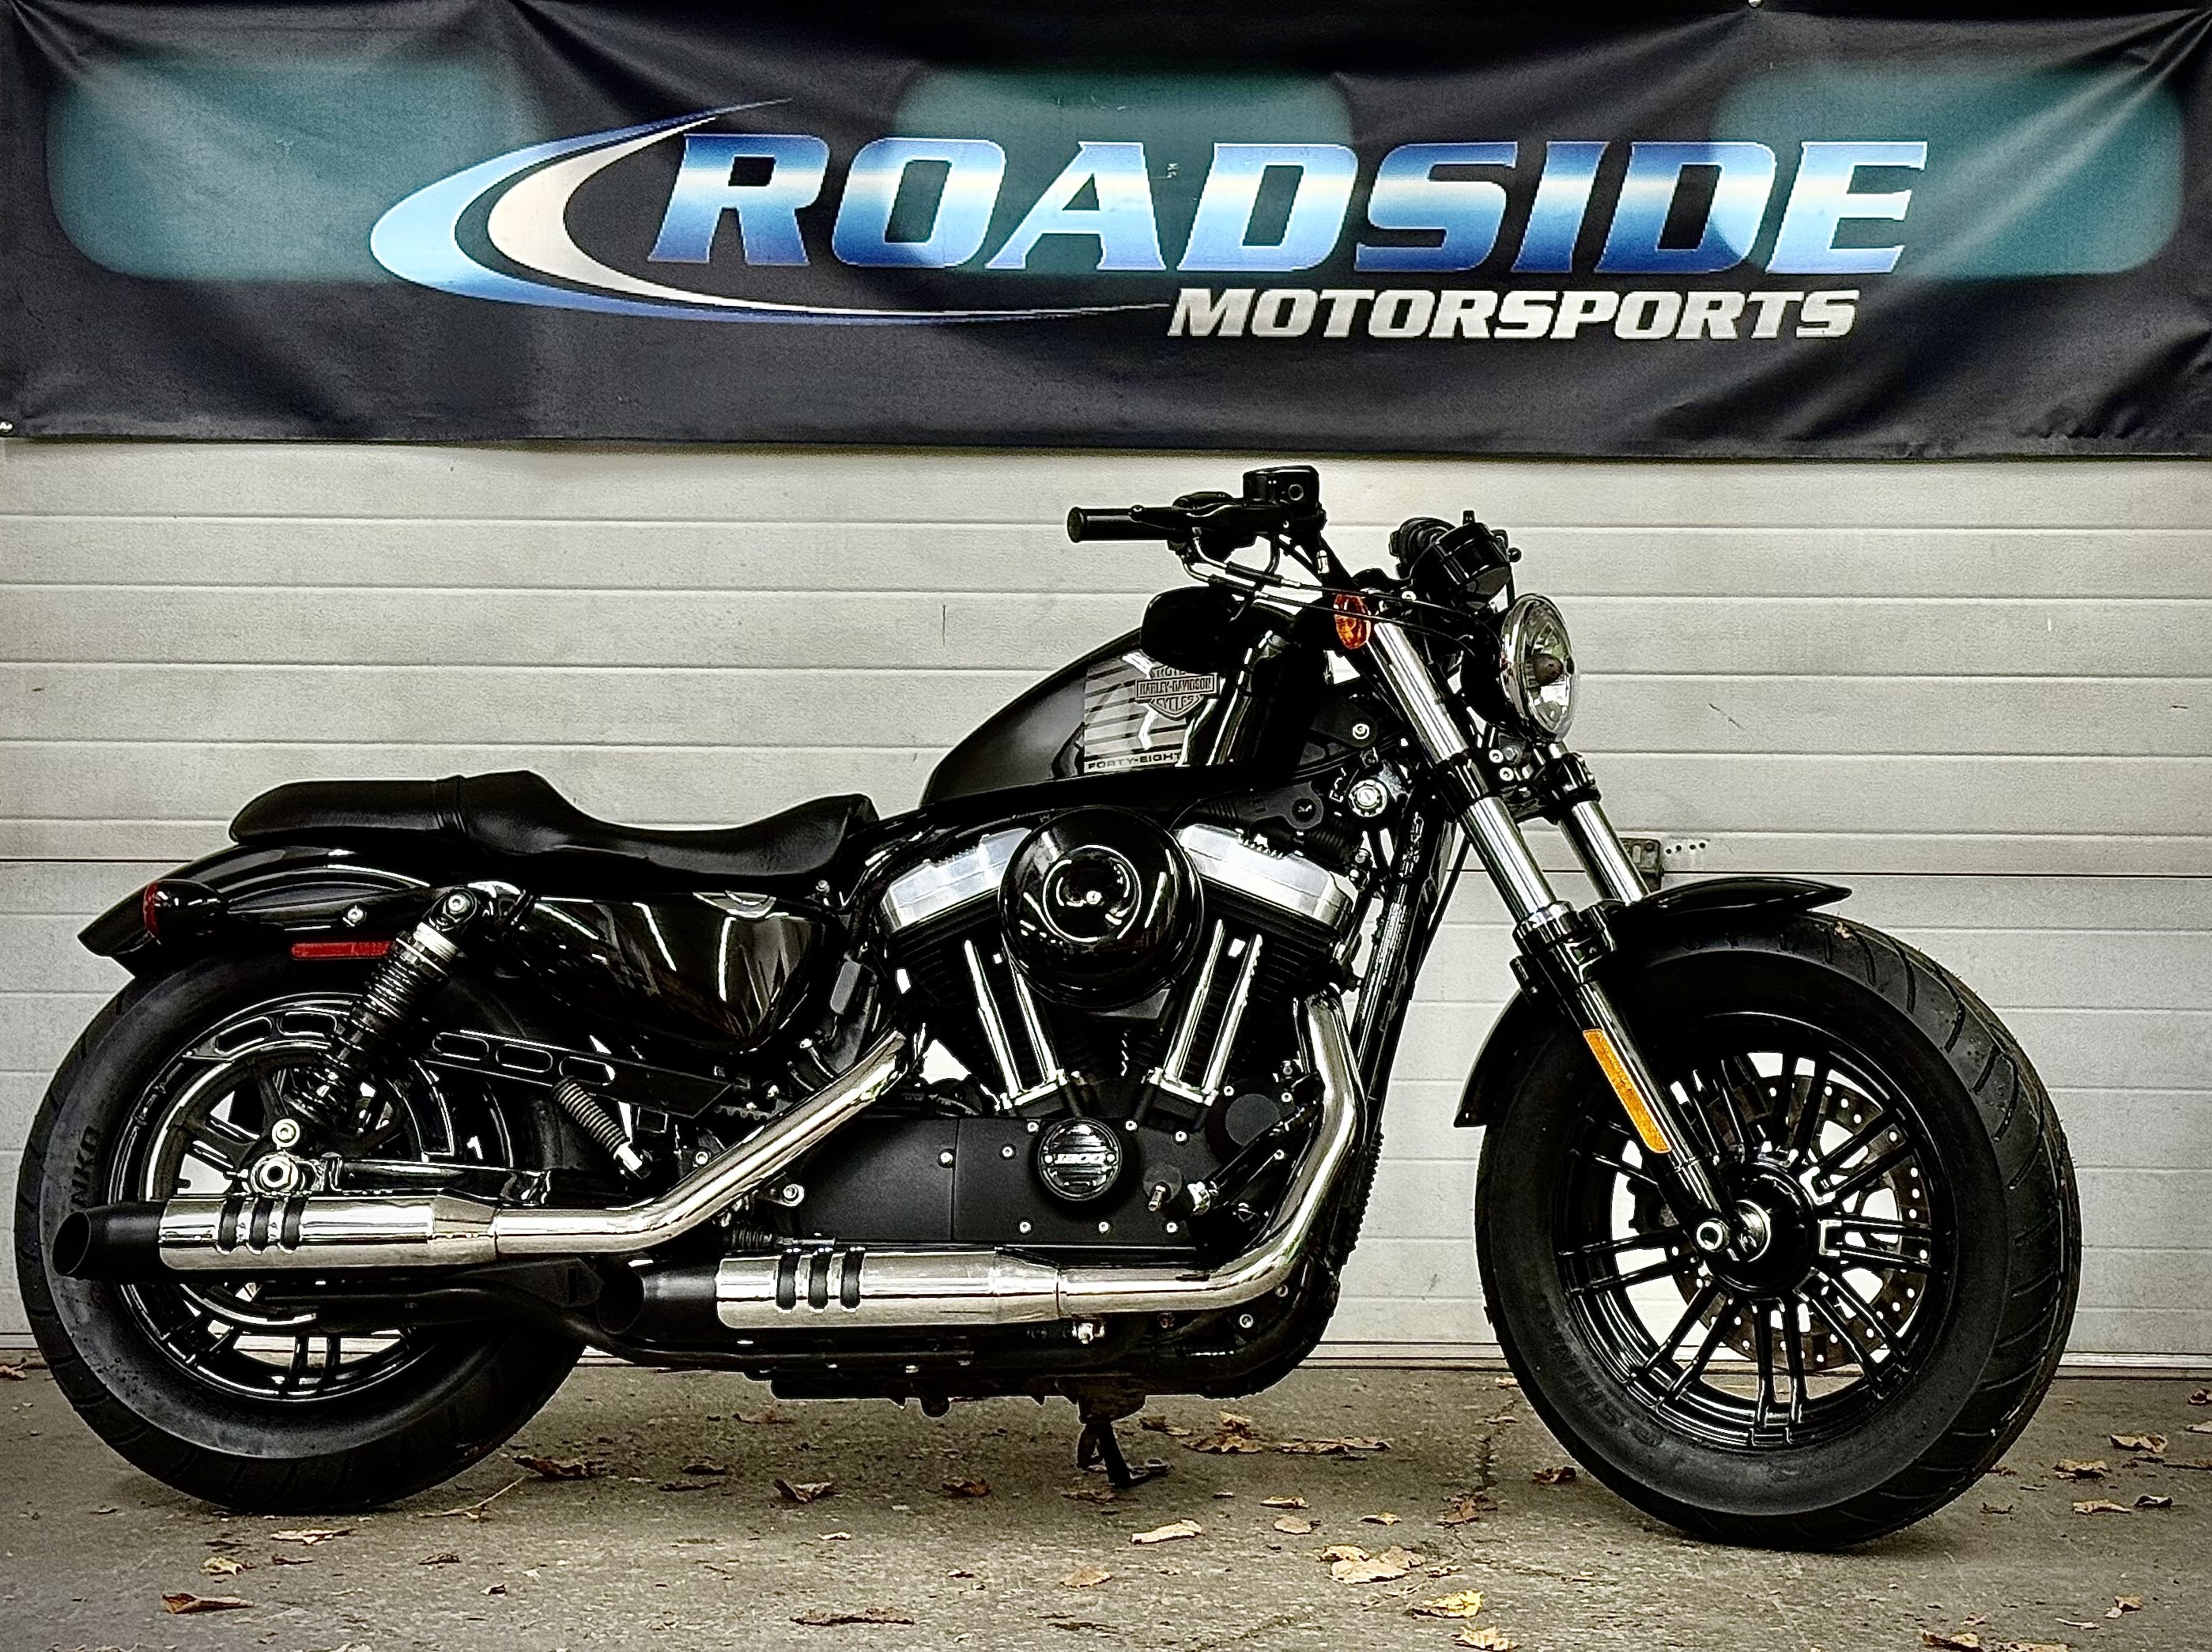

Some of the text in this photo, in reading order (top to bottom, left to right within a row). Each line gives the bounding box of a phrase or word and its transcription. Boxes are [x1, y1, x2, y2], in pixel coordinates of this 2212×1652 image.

[647, 134, 1928, 274] ROADSIDE
[1167, 288, 1859, 341] MOTORSPORTS
[1088, 752, 1181, 769] FORTY-EIGHT
[70, 1126, 98, 1209] NKO
